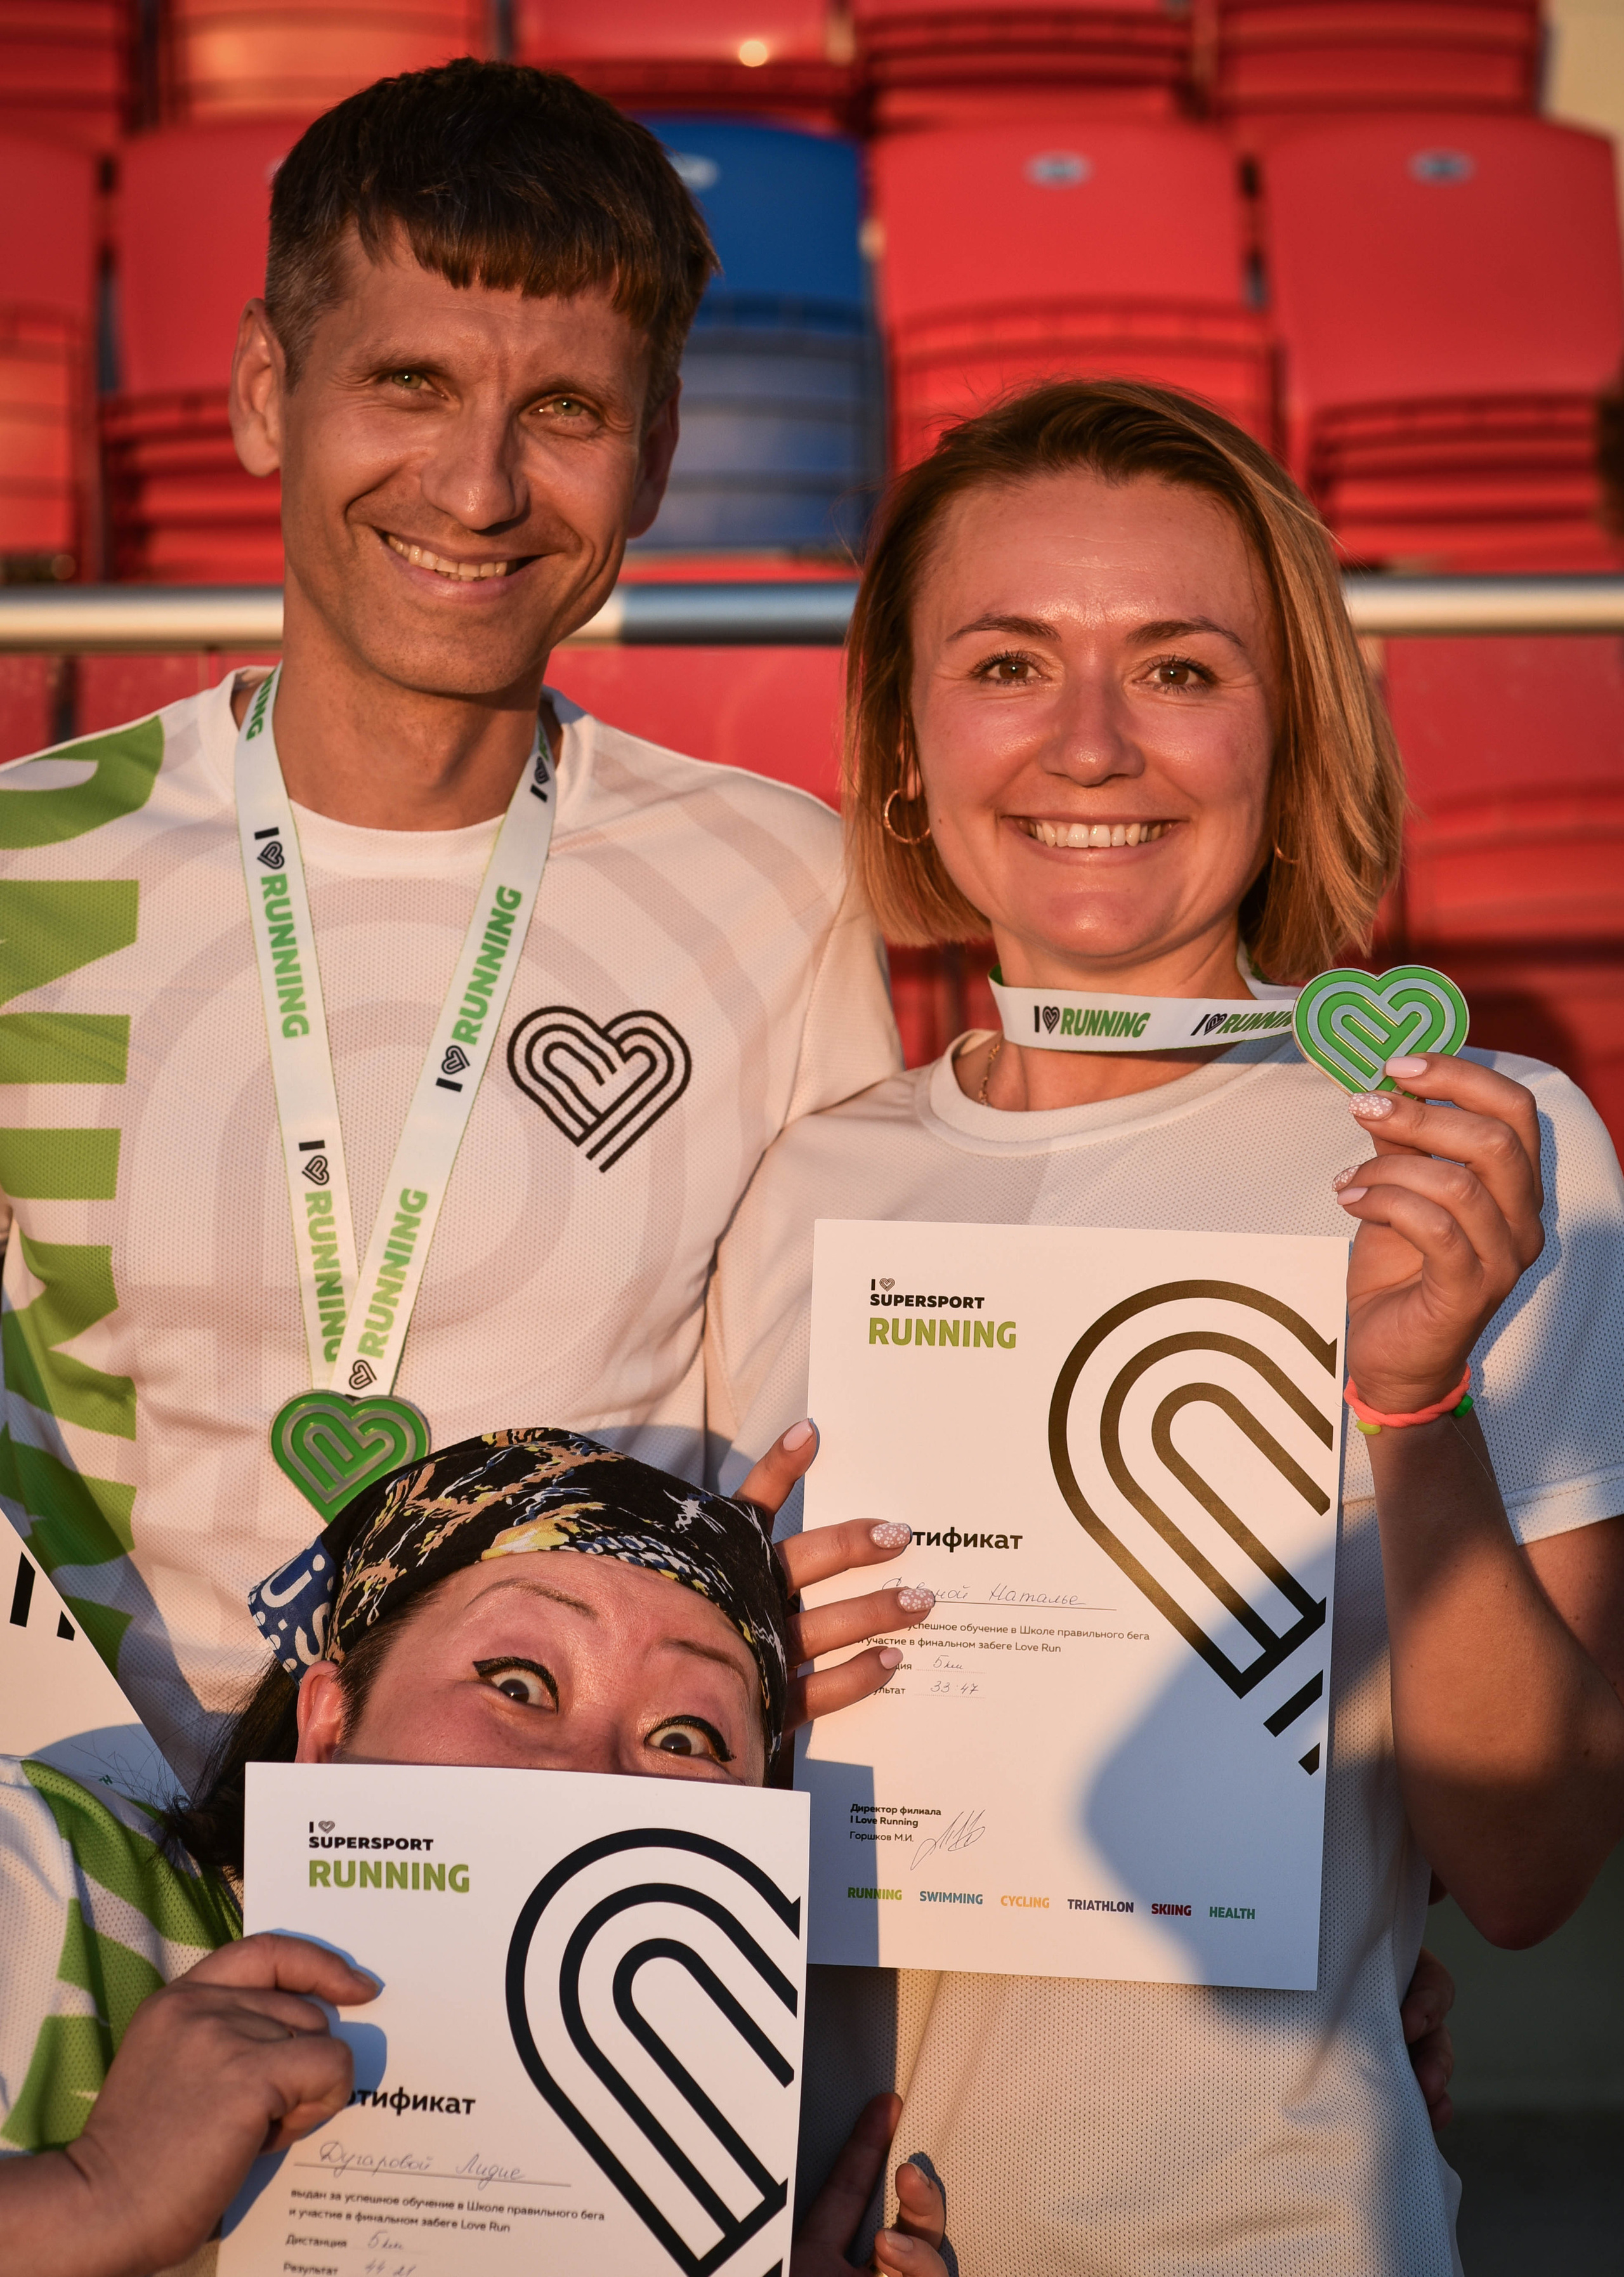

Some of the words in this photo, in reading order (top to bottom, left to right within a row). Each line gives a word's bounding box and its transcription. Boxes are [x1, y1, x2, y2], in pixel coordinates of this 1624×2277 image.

[254, 827, 279, 840] I
[260, 873, 310, 1039] RUNNING
[436, 1077, 463, 1092] I
[451, 886, 522, 1046] RUNNING
[1034, 1005, 1040, 1033] I
[1060, 1007, 1151, 1038] RUNNING
[1215, 1011, 1292, 1035] RUNNIN
[298, 1139, 325, 1152] I
[357, 1187, 429, 1359] RUNNING
[870, 1278, 876, 1291] I
[870, 1293, 985, 1309] SUPERSPORT
[868, 1316, 1016, 1349] RUNNING
[912, 1526, 1023, 1553] тификат
[989, 1582, 1087, 1606] Наталье
[960, 1623, 1008, 1634] обучение
[1019, 1625, 1055, 1636] Школе
[1058, 1630, 1124, 1640] правильного
[1127, 1631, 1150, 1641] бега
[867, 1637, 907, 1646] участие
[917, 1637, 976, 1648] финальном
[978, 1641, 1012, 1650] забеге
[1015, 1642, 1038, 1651] Love
[1041, 1643, 1061, 1652] Run
[850, 1804, 898, 1814] Директор
[900, 1806, 941, 1816] филиала
[309, 1821, 314, 1834] I
[850, 1815, 853, 1823] I
[855, 1816, 877, 1824] Love
[880, 1816, 919, 1828] Running
[308, 1836, 434, 1851] SUPERSPORT
[849, 1831, 891, 1841] Горшков
[894, 1833, 914, 1842] М.И.
[309, 1860, 469, 1893] RUNNING
[848, 1887, 902, 1900] RUNNING
[919, 1891, 983, 1905] SWIMMING
[1000, 1894, 1049, 1908] CYCLING
[1068, 1899, 1134, 1913] TRIATHLON
[1151, 1903, 1192, 1916] SKIING
[1209, 1906, 1255, 1919] HEALTH
[348, 2087, 476, 2116] тификат
[291, 2189, 326, 2200] выдан
[329, 2193, 341, 2201] за
[344, 2193, 400, 2204] успешное
[402, 2197, 455, 2209] обучение
[457, 2202, 464, 2210] в
[467, 2201, 504, 2214] Школе
[507, 2205, 578, 2219] правильного
[580, 2210, 605, 2221] бега
[289, 2207, 296, 2215] и
[298, 2208, 343, 2220] участие
[354, 2211, 419, 2226] финальном
[421, 2216, 457, 2229] забеге
[461, 2220, 487, 2231] Love
[489, 2222, 511, 2233] Run
[285, 2233, 348, 2248] Дистанция
[283, 2261, 338, 2276] Результат
